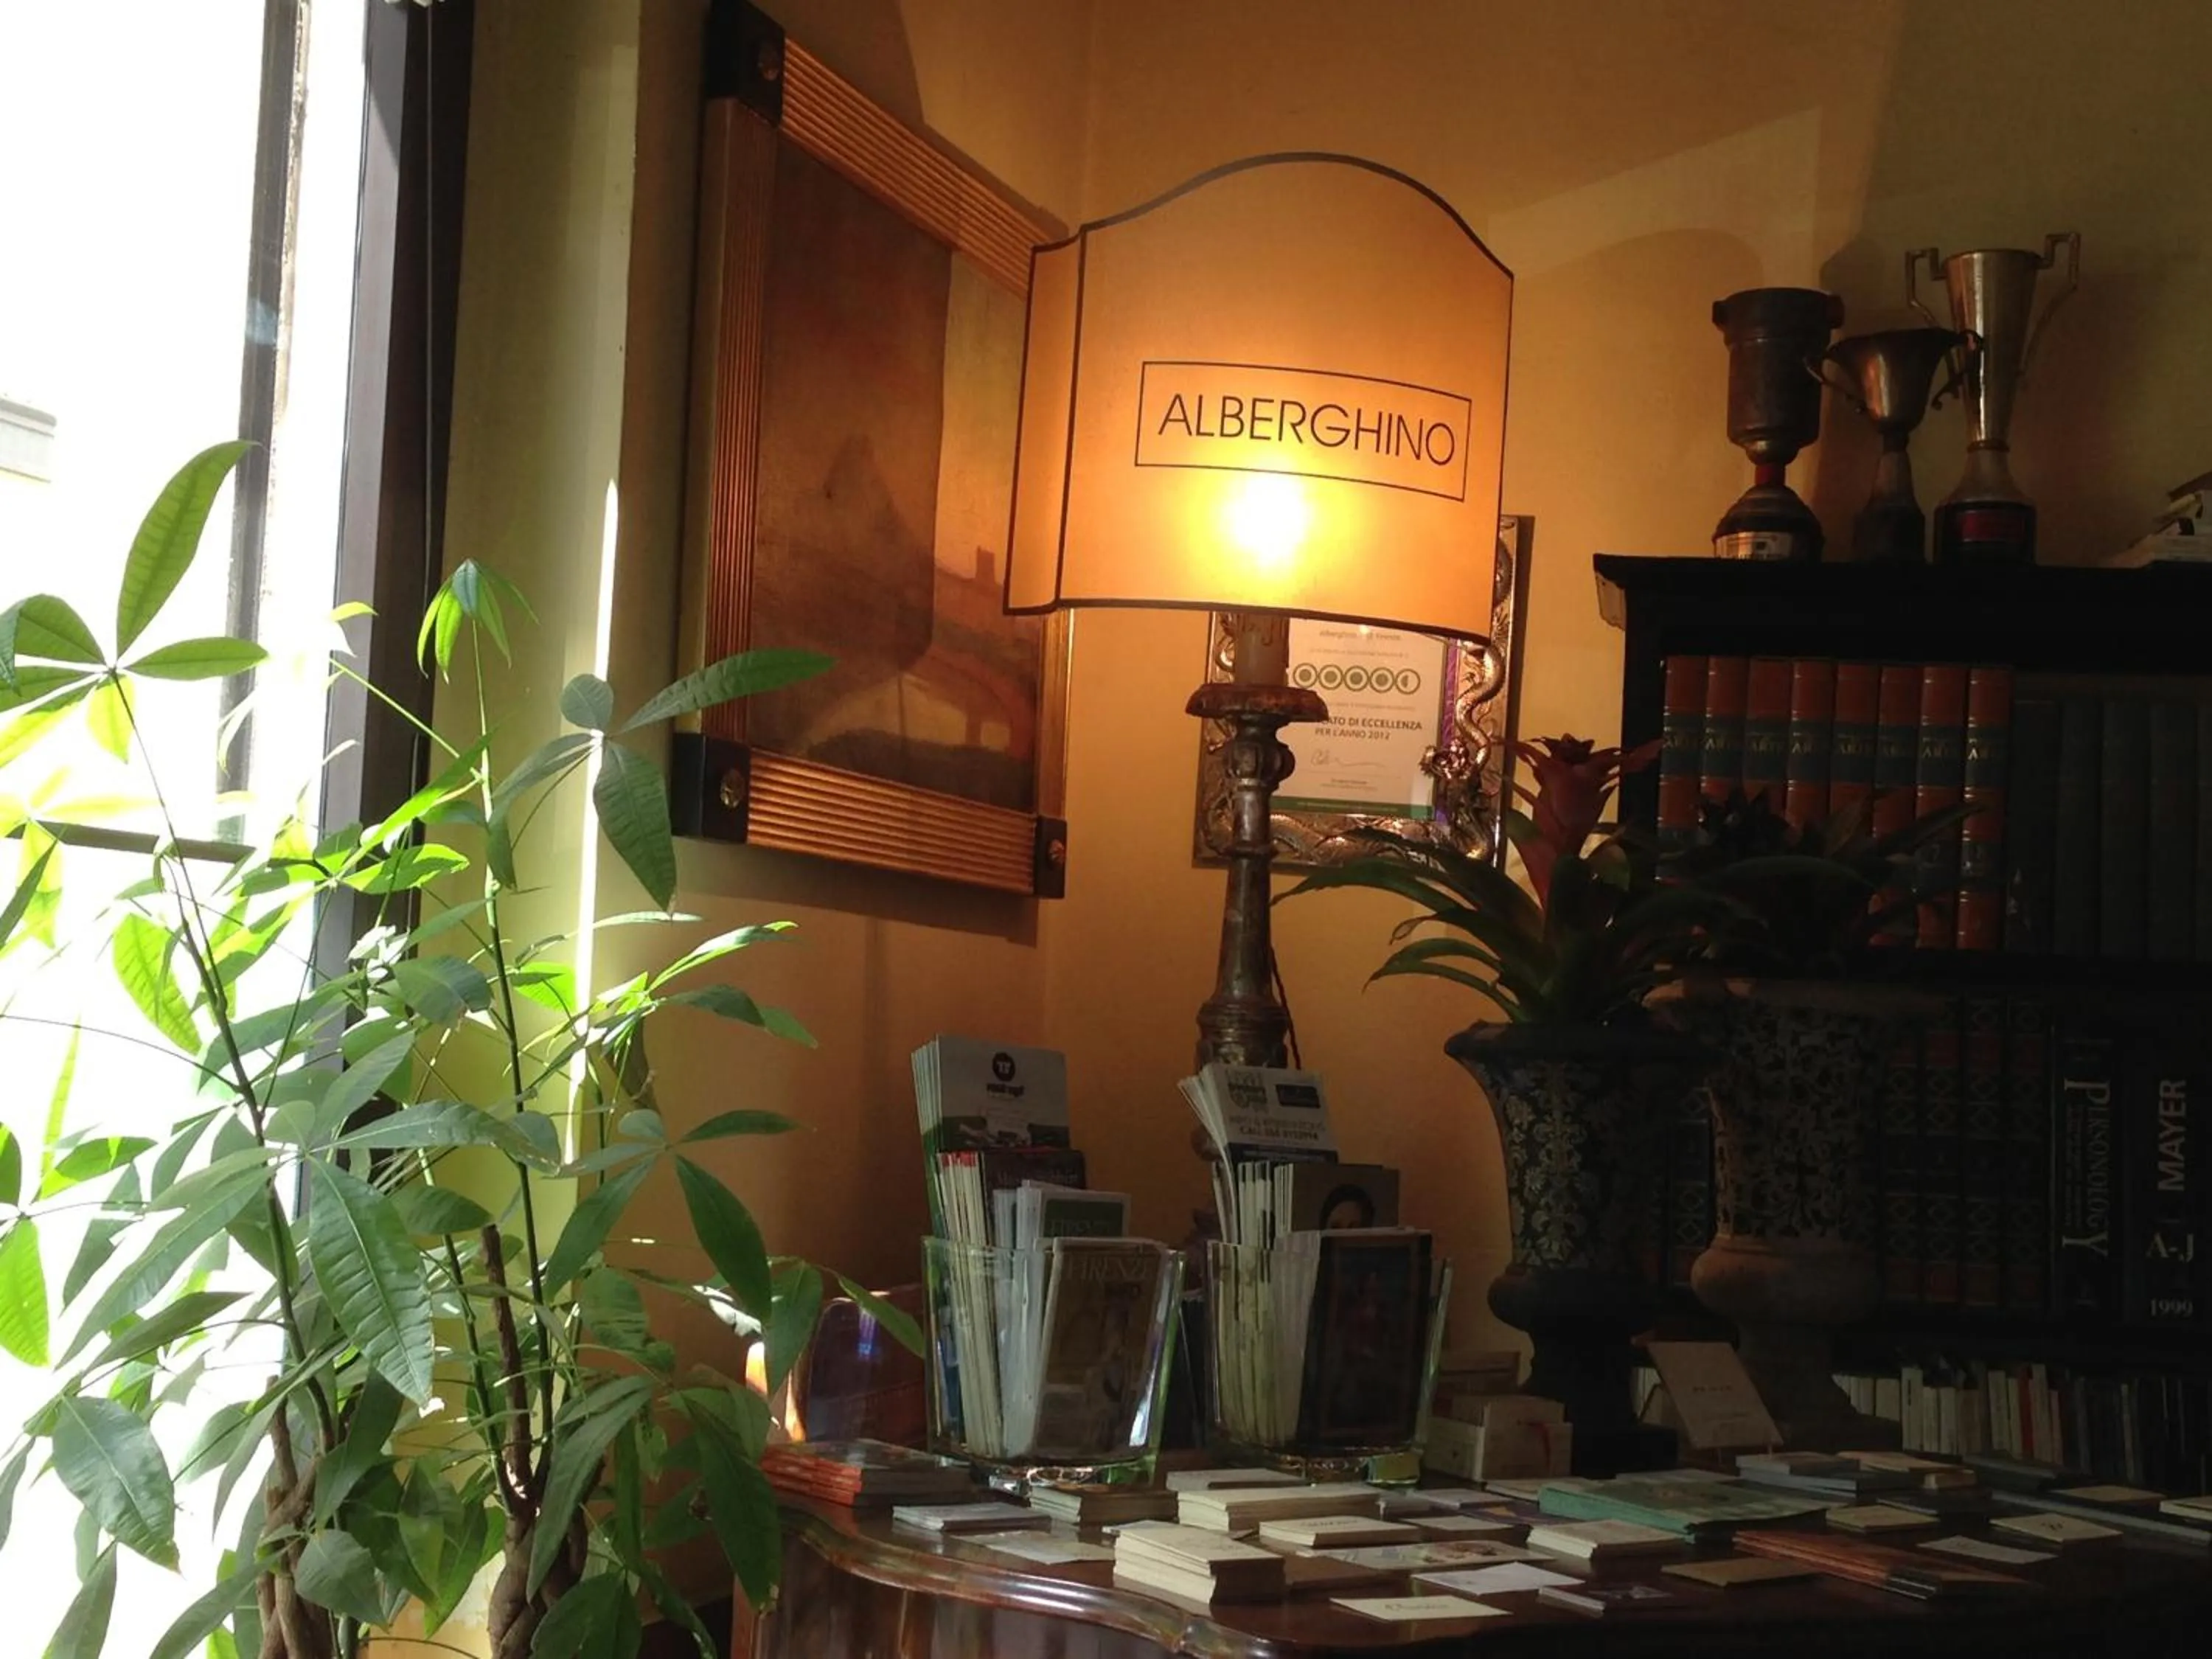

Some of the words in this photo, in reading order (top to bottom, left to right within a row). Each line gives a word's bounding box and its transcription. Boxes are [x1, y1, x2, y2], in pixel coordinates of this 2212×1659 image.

[1158, 393, 1455, 465] ALBERGHINO
[1315, 728, 1332, 737] PER
[1368, 730, 1391, 741] 2012
[1349, 717, 1360, 728] DI
[1361, 718, 1423, 731] ECCELLENZA
[2157, 1078, 2188, 1193] MAYER
[2062, 1078, 2111, 1257] PERSONOLOGY
[2146, 1231, 2194, 1263] A-J
[2149, 1296, 2194, 1319] 1999
